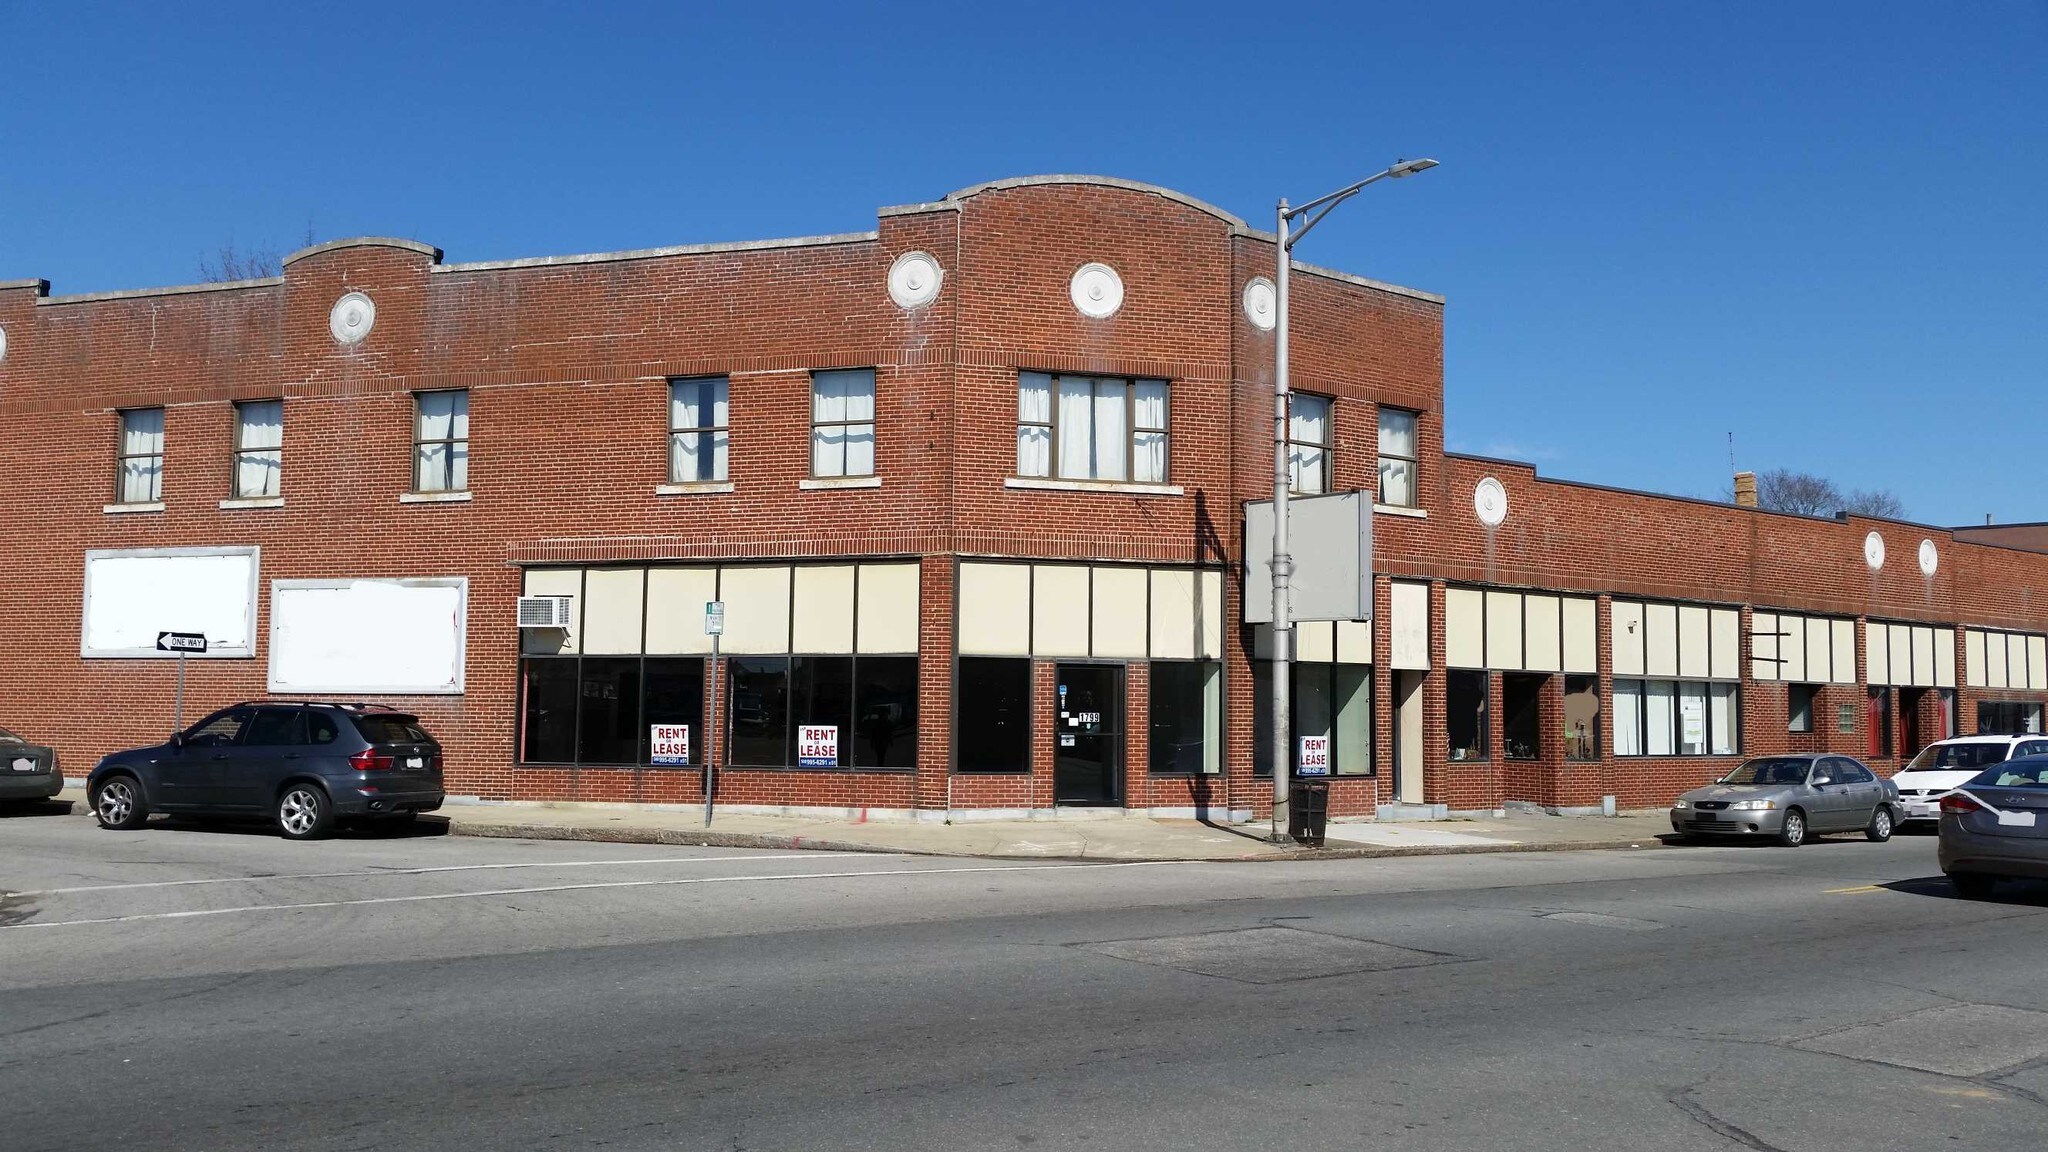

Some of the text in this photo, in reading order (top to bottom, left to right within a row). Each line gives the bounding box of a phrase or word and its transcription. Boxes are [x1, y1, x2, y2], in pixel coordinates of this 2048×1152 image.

[172, 637, 203, 647] ONE WAY
[1080, 713, 1099, 722] 1799
[658, 728, 687, 739] RENT
[806, 729, 836, 740] RENT
[653, 743, 687, 755] LEASE
[1305, 739, 1326, 750] RENT
[800, 745, 836, 756] LEASE
[1301, 754, 1326, 765] LEASE
